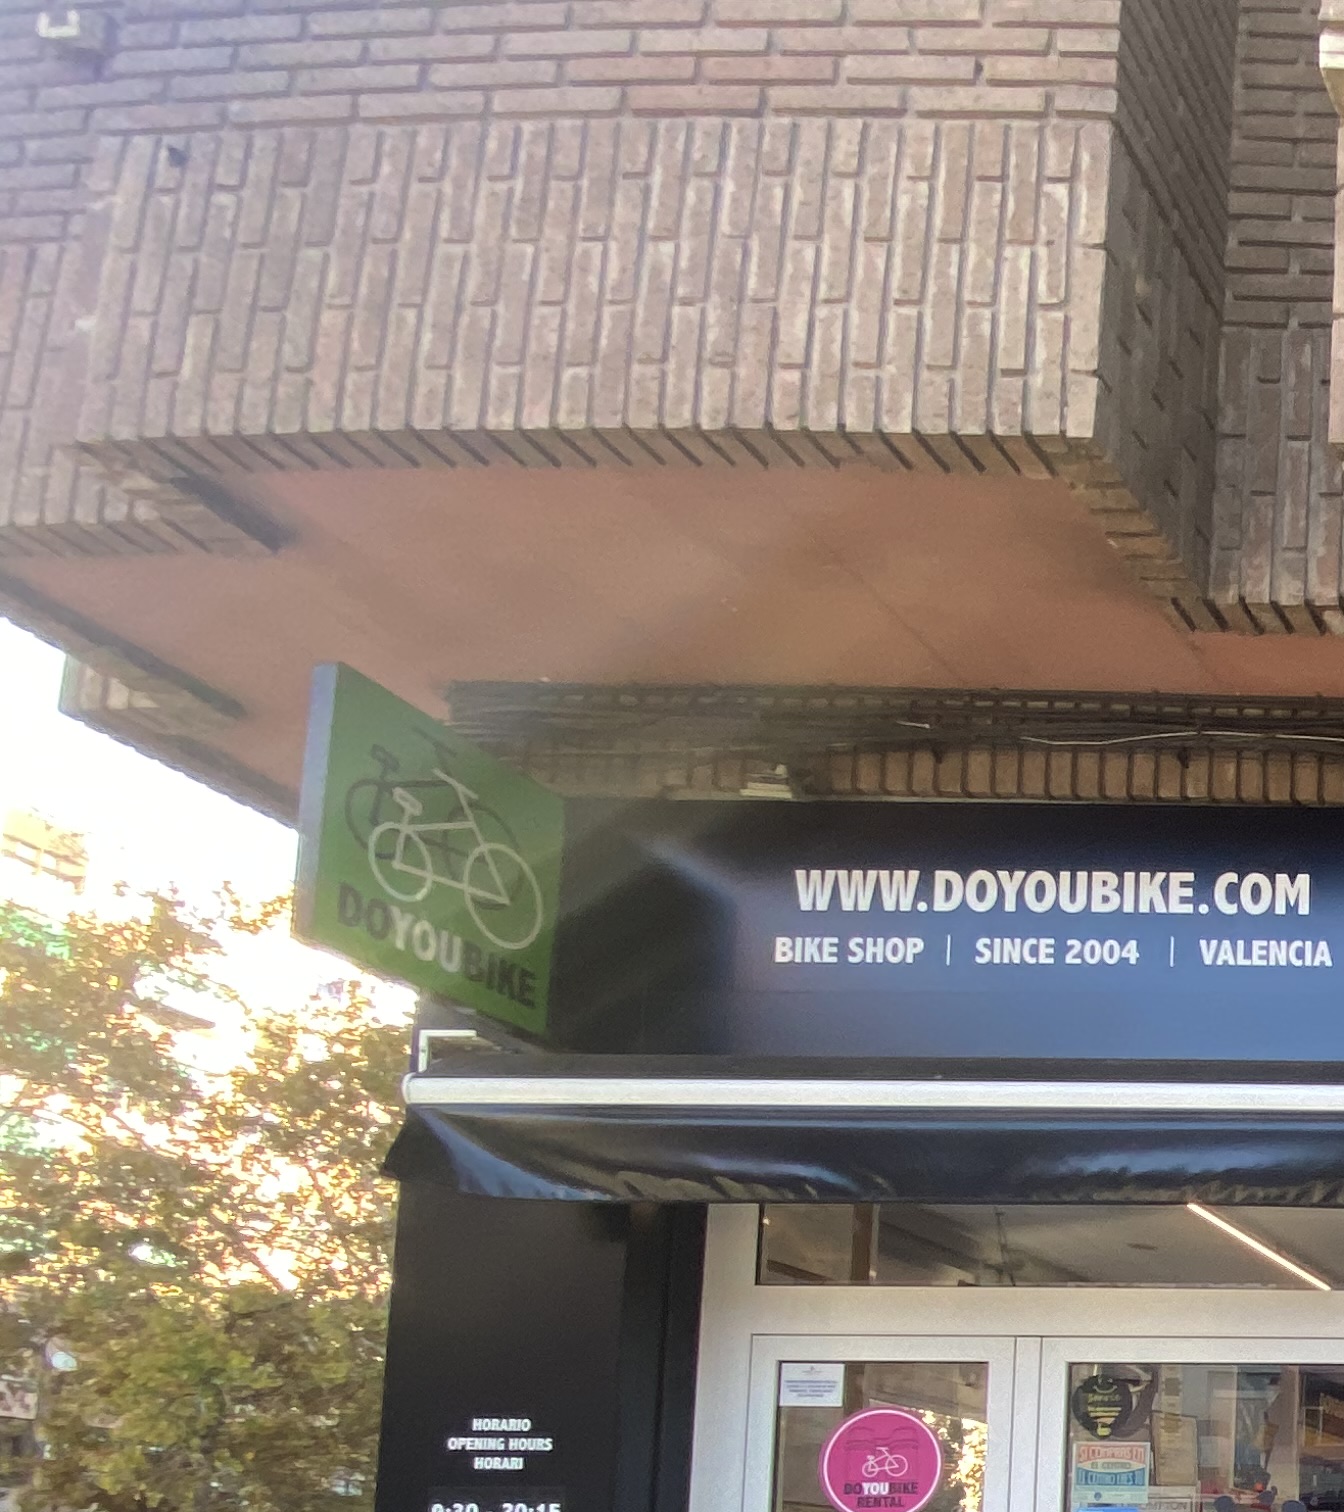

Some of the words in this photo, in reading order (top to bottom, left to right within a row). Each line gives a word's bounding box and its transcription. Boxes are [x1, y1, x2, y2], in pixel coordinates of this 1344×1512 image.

[795, 868, 1311, 916] WWW.DOYOUBIKE.COM
[337, 881, 538, 1008] DOYOUBIKE
[774, 936, 839, 965] BIKE
[847, 936, 924, 966] SHOP
[975, 936, 1055, 966] SINCE
[1064, 938, 1139, 966] 2004
[1200, 938, 1333, 968] VALENCIA
[472, 1418, 531, 1432] HORARIO
[447, 1437, 505, 1452] OPENING
[508, 1438, 553, 1452] HOURS
[474, 1457, 523, 1471] HORARI
